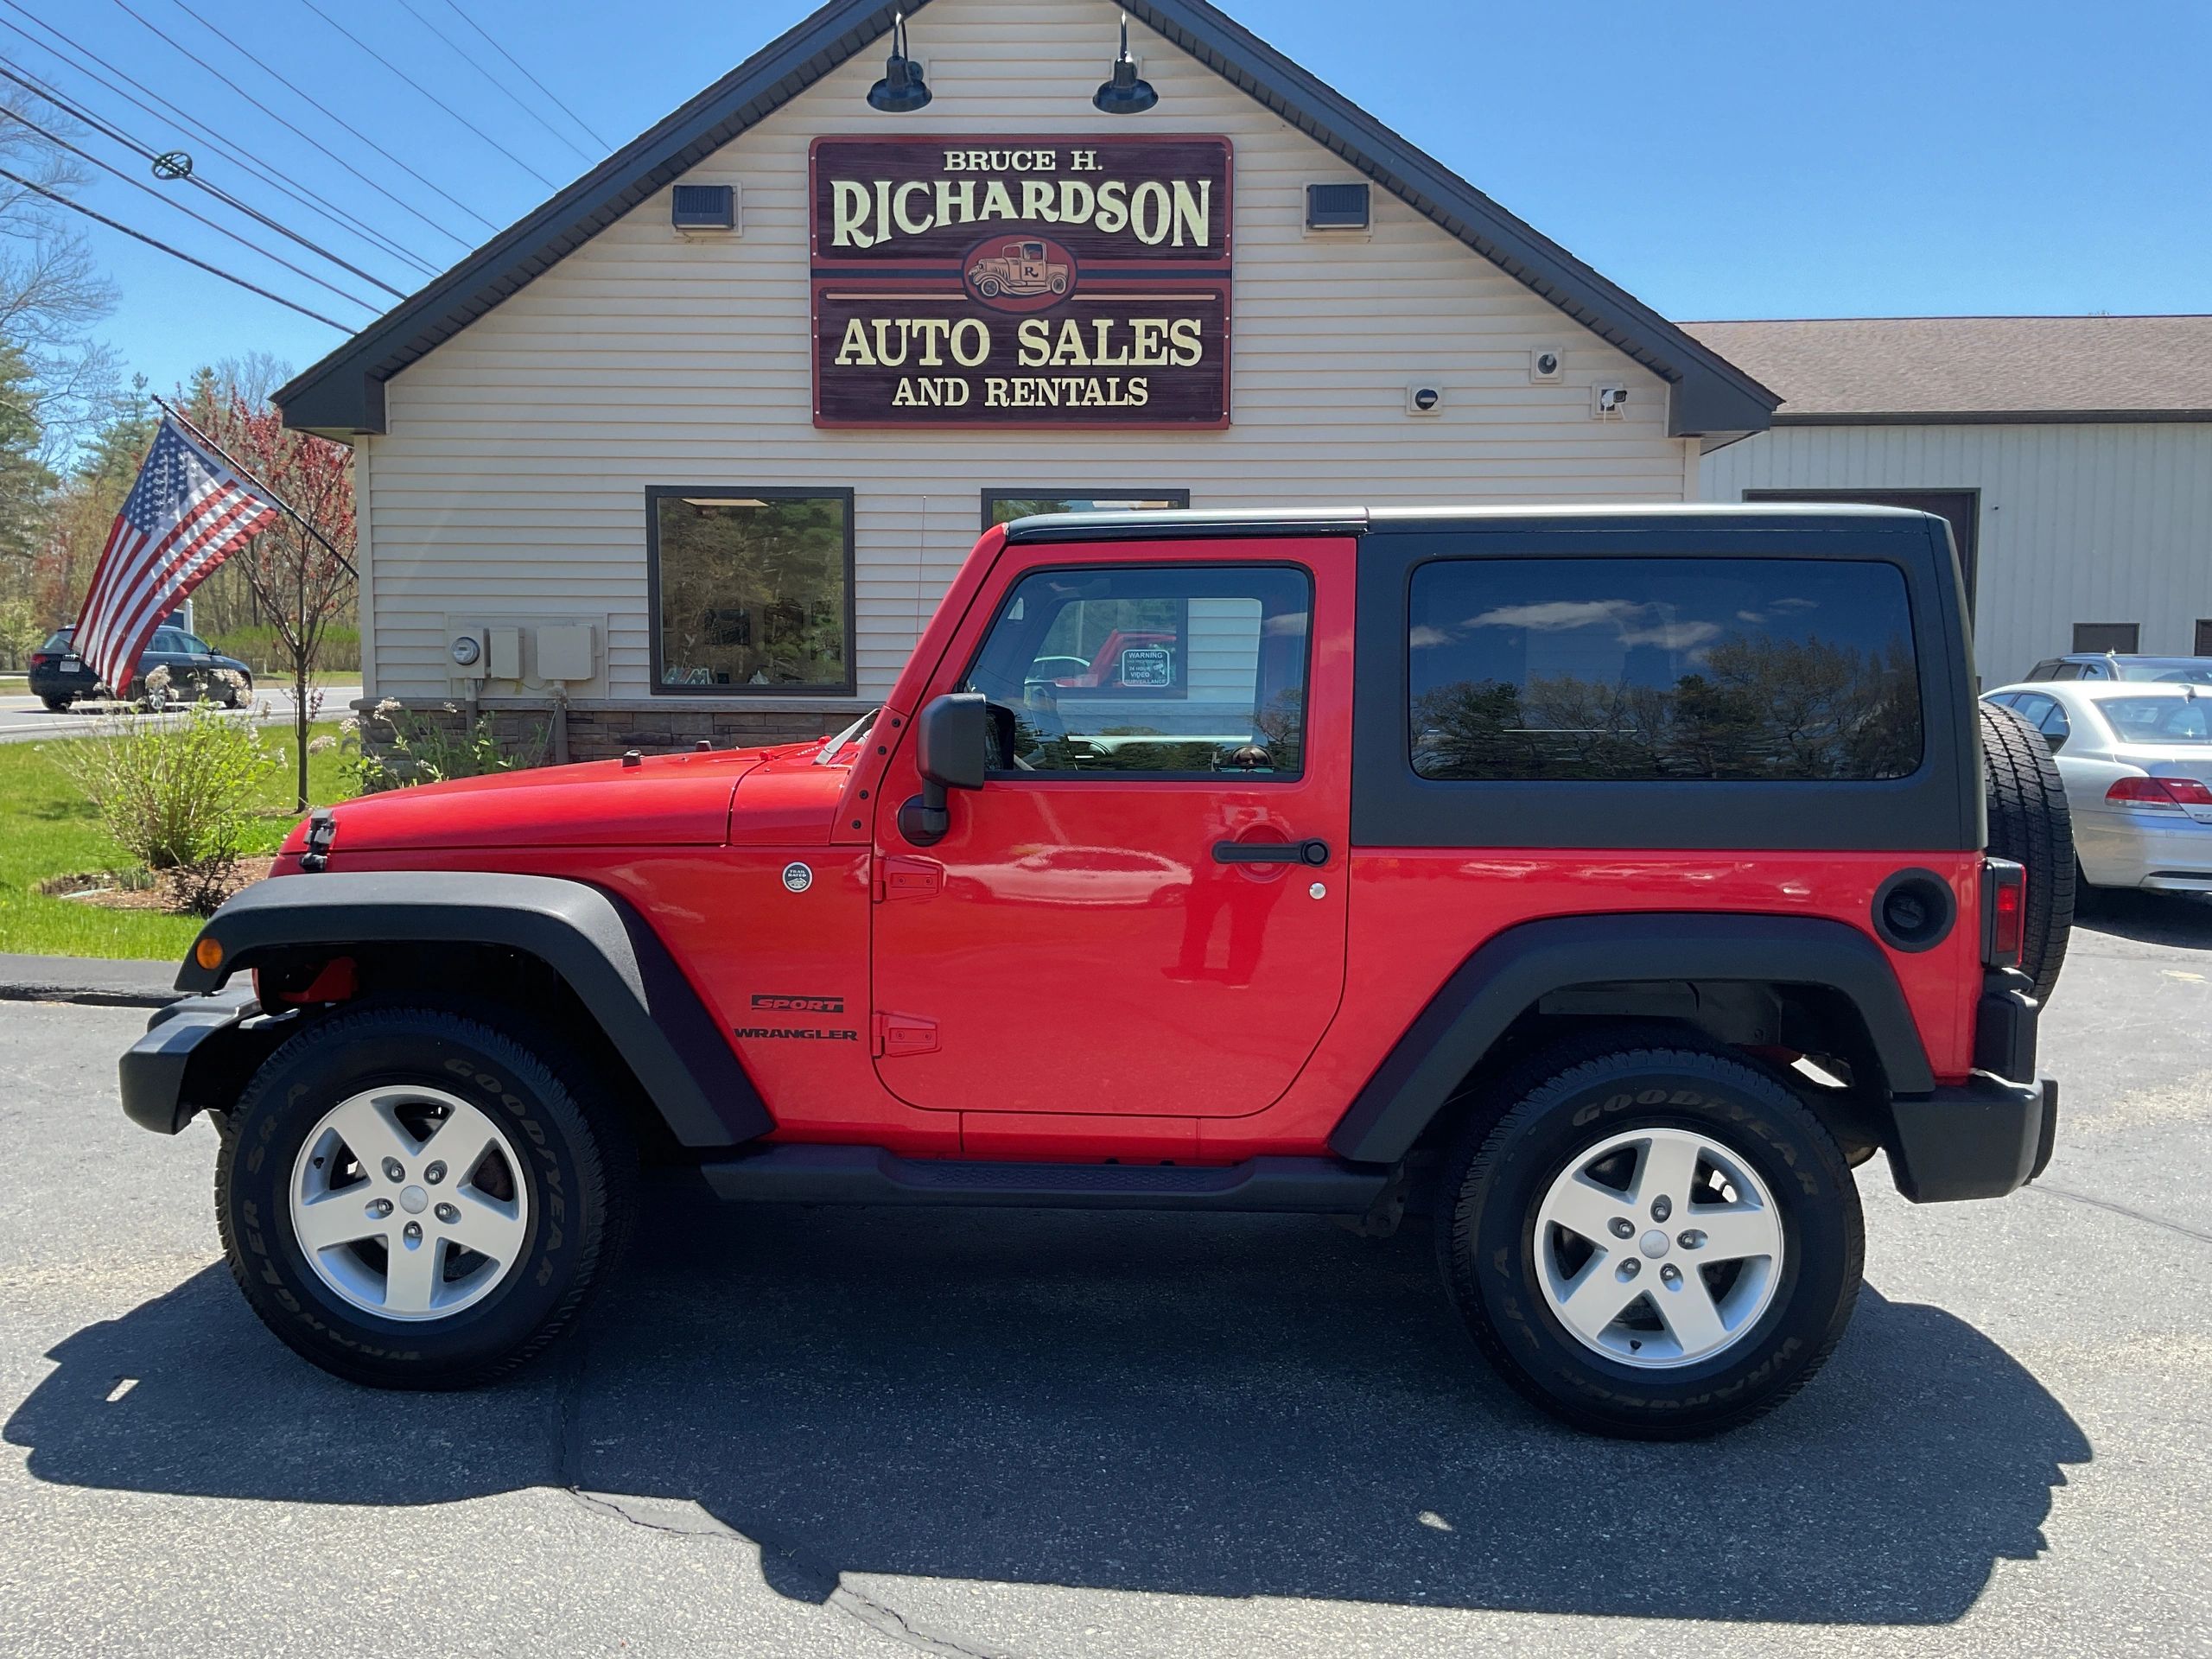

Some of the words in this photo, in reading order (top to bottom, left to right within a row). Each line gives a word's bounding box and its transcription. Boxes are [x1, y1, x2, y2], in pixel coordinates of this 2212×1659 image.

[944, 150, 1056, 171] BRUCE
[1070, 150, 1103, 171] H.
[830, 179, 1211, 249] RICHARDSON
[1025, 266, 1039, 278] R
[834, 318, 990, 366] AUTO
[1018, 318, 1202, 366] SALES
[892, 378, 969, 406] AND
[983, 377, 1148, 408] RENTALS
[756, 998, 843, 1011] SPORT
[734, 1028, 858, 1041] WRANGLER
[1572, 1089, 1821, 1196] GOODYEAR
[442, 1058, 567, 1287] GOODYEAR
